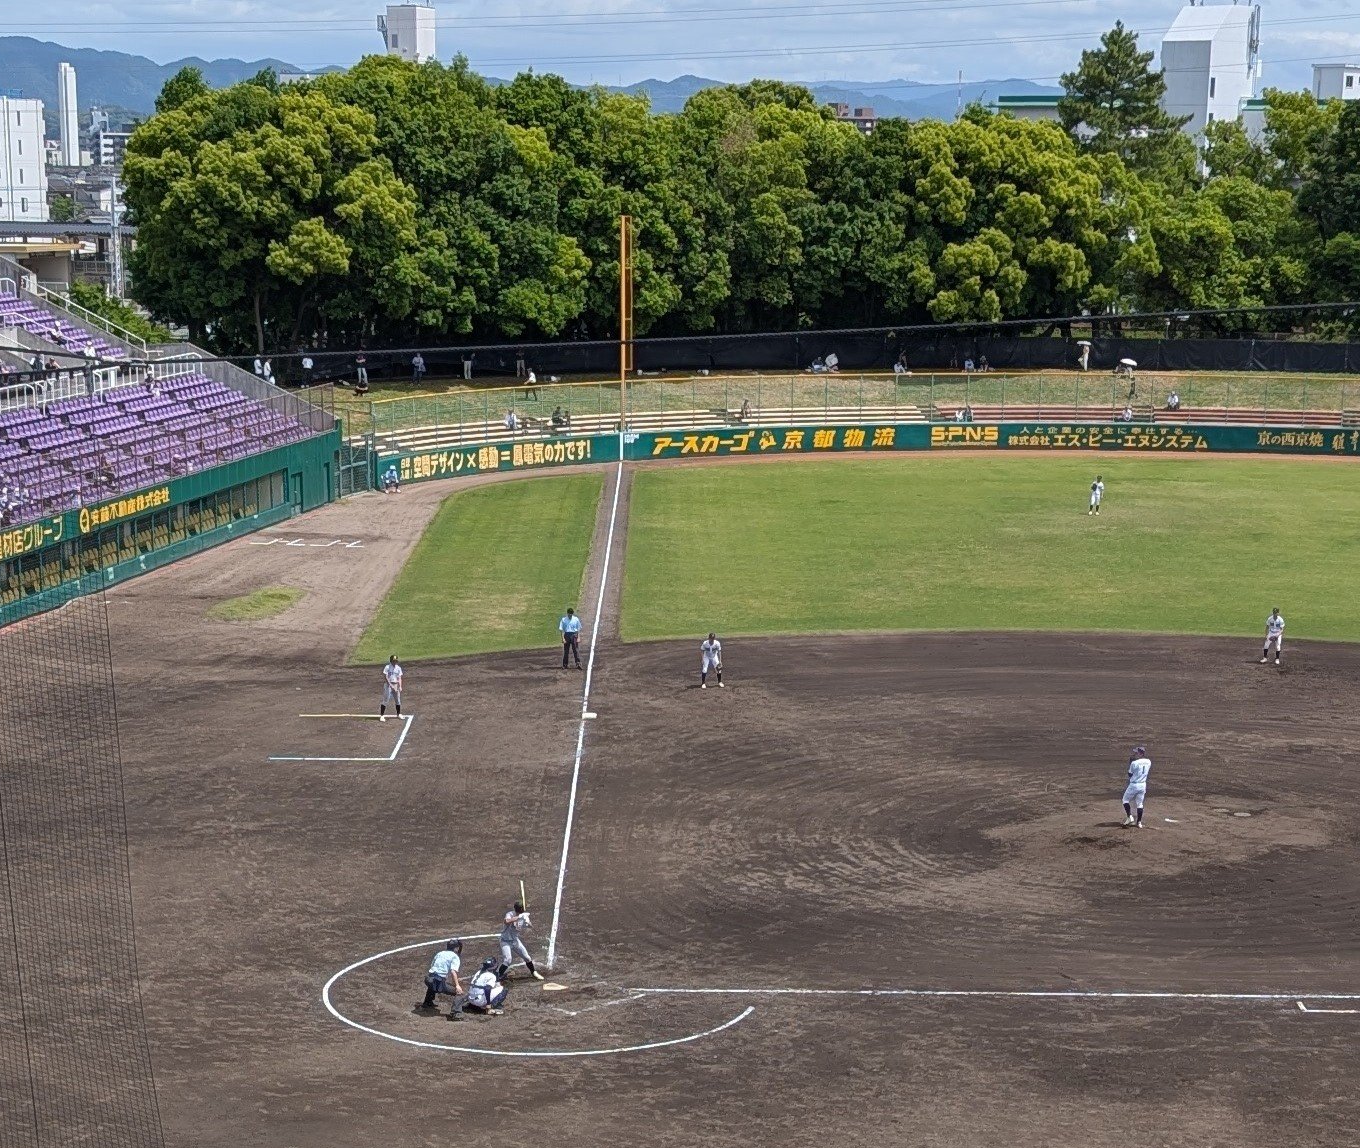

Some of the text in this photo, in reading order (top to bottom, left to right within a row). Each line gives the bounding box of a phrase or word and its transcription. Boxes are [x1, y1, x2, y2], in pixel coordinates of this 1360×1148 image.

[652, 431, 755, 455] アースカーゴ
[782, 427, 895, 449] 京都物流
[1008, 435, 1050, 446] 株式会社
[1257, 430, 1324, 447] 京の西京焼
